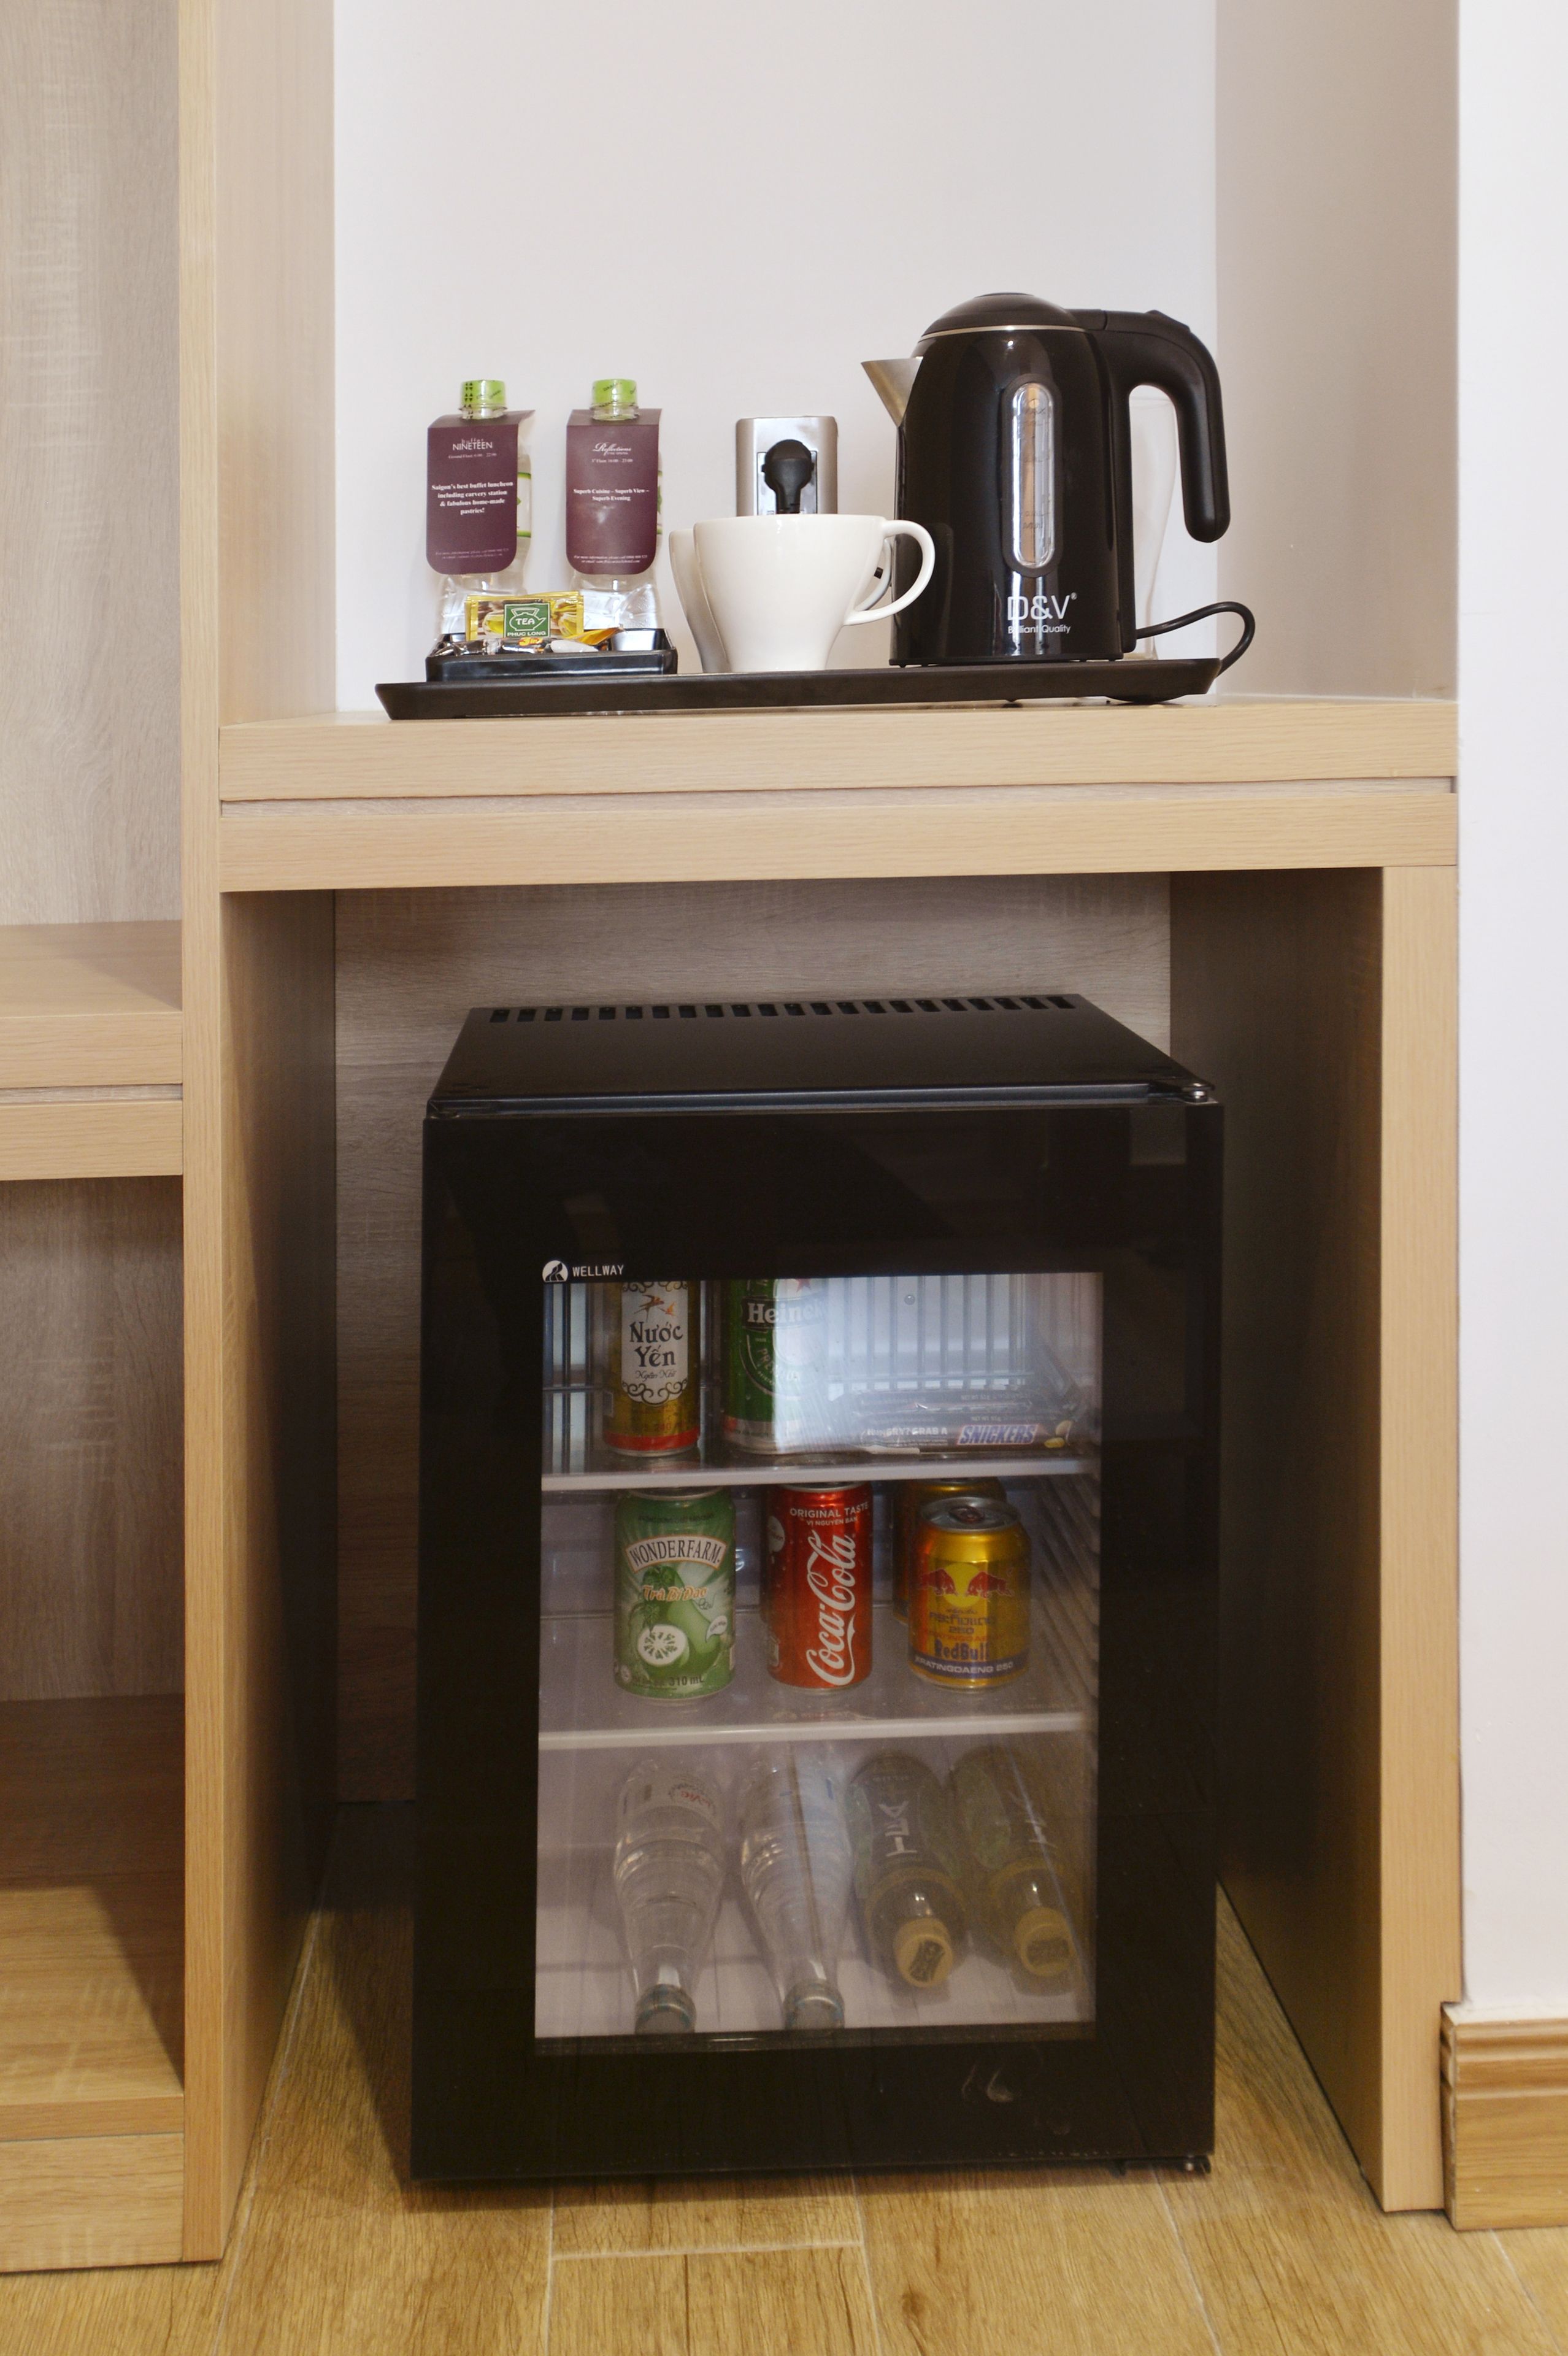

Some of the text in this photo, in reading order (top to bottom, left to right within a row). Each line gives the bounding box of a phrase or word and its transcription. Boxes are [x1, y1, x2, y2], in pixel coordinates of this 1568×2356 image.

[452, 442, 493, 450] NINETEEN
[592, 442, 632, 456] Reflections
[460, 507, 485, 515] pastries!
[1042, 625, 1071, 634] Quality
[572, 1265, 624, 1277] WELLWAY
[629, 1321, 683, 1344] Nước
[634, 1345, 676, 1368] Yến
[912, 1427, 939, 1436] GRAB
[959, 1425, 1036, 1444] SNICKERS
[790, 1501, 869, 1519] ORIGINAL TASTE
[806, 1530, 856, 1686] Coca-Cola
[669, 1676, 687, 1686] 310
